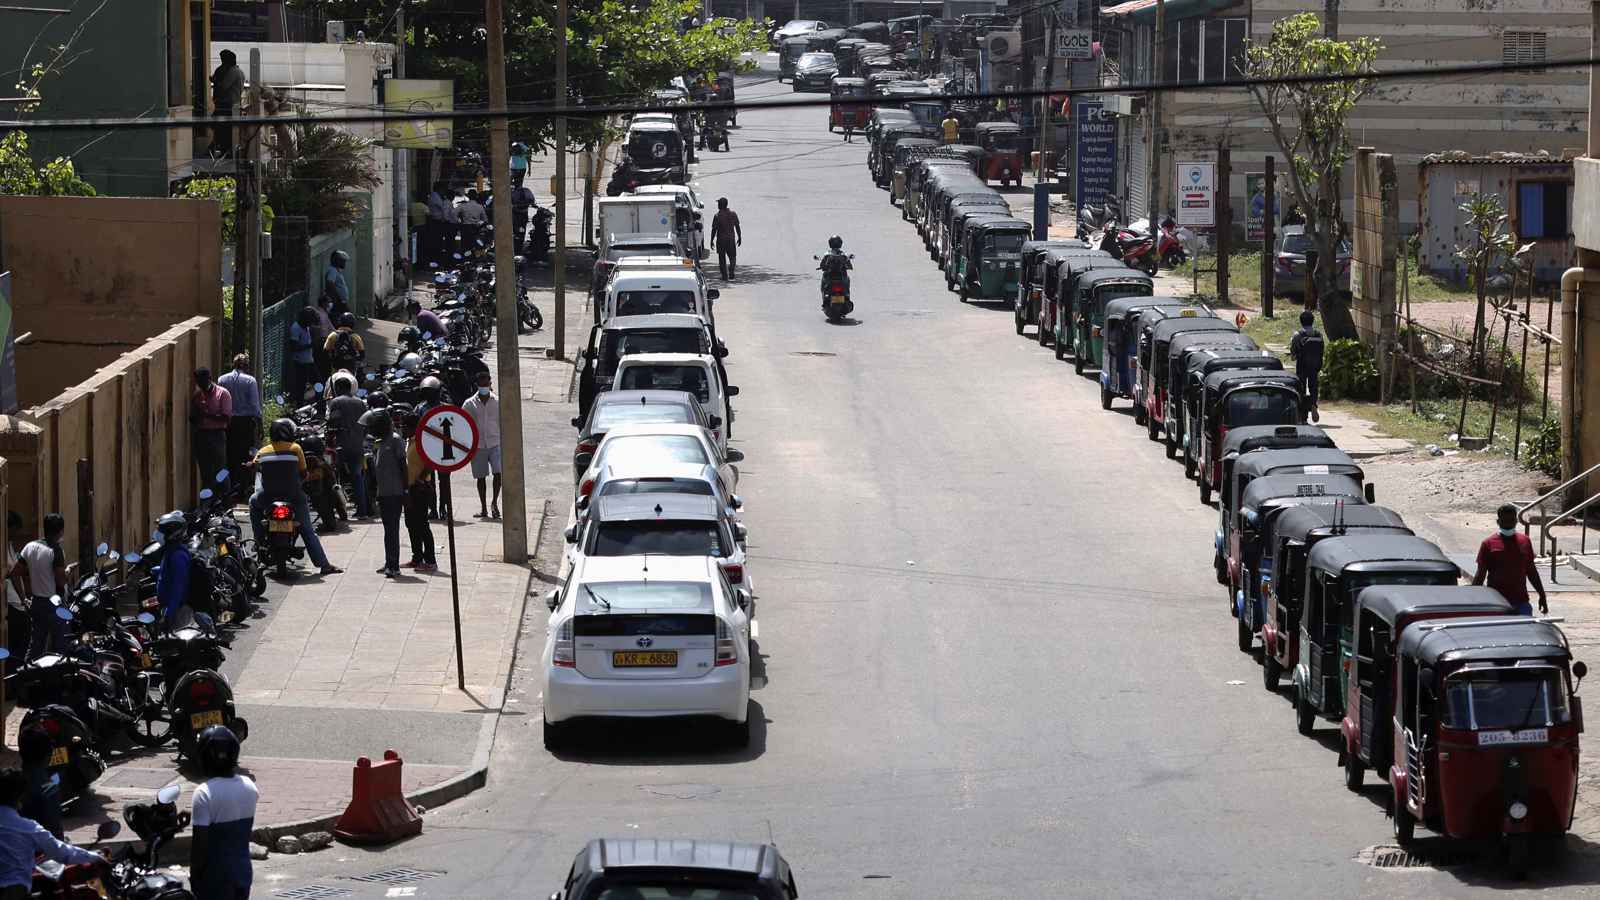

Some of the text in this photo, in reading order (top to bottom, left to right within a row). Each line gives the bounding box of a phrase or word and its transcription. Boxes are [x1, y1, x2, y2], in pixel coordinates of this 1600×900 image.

[1060, 32, 1088, 47] roots
[1088, 107, 1109, 120] PC
[1081, 124, 1113, 133] WORLD
[624, 653, 638, 664] KR
